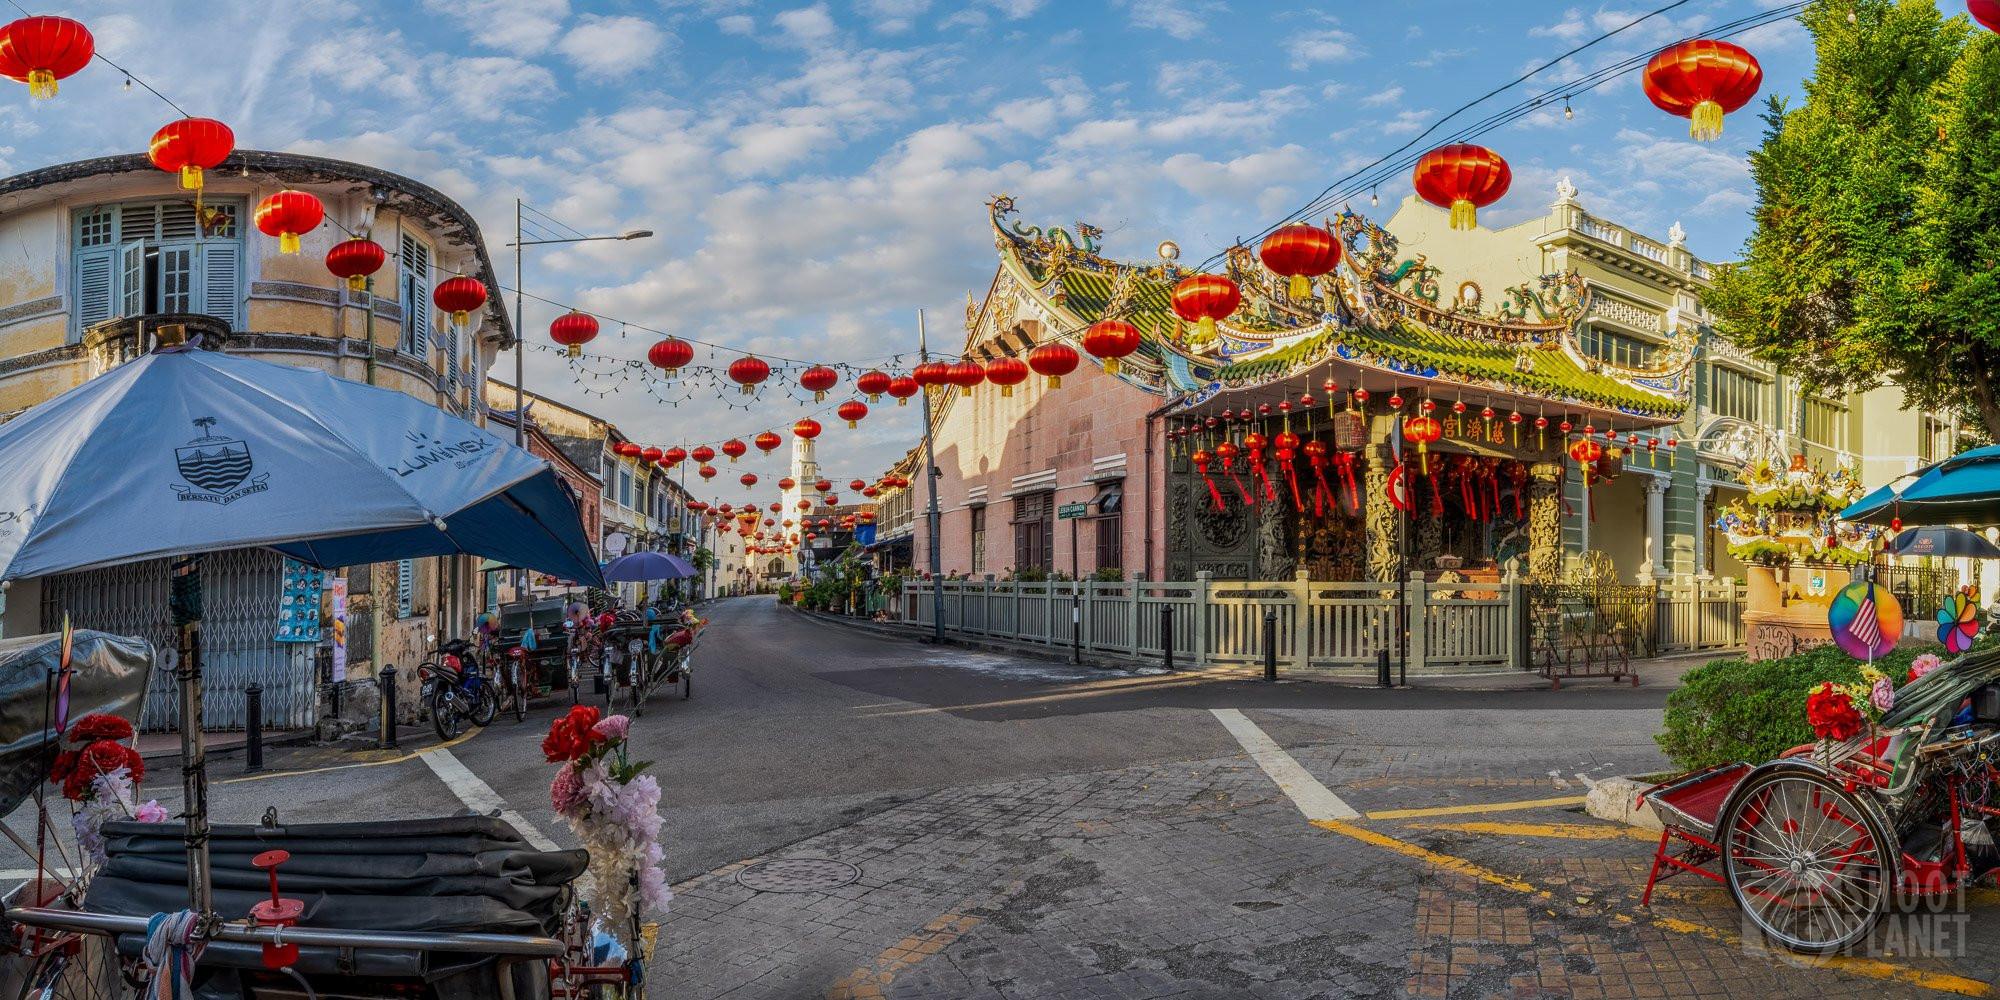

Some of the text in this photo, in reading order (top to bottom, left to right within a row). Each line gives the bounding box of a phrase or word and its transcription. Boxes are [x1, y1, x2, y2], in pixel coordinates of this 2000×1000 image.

[1712, 466, 1729, 482] YAP
[181, 484, 265, 504] BERSATU DAN SETIA
